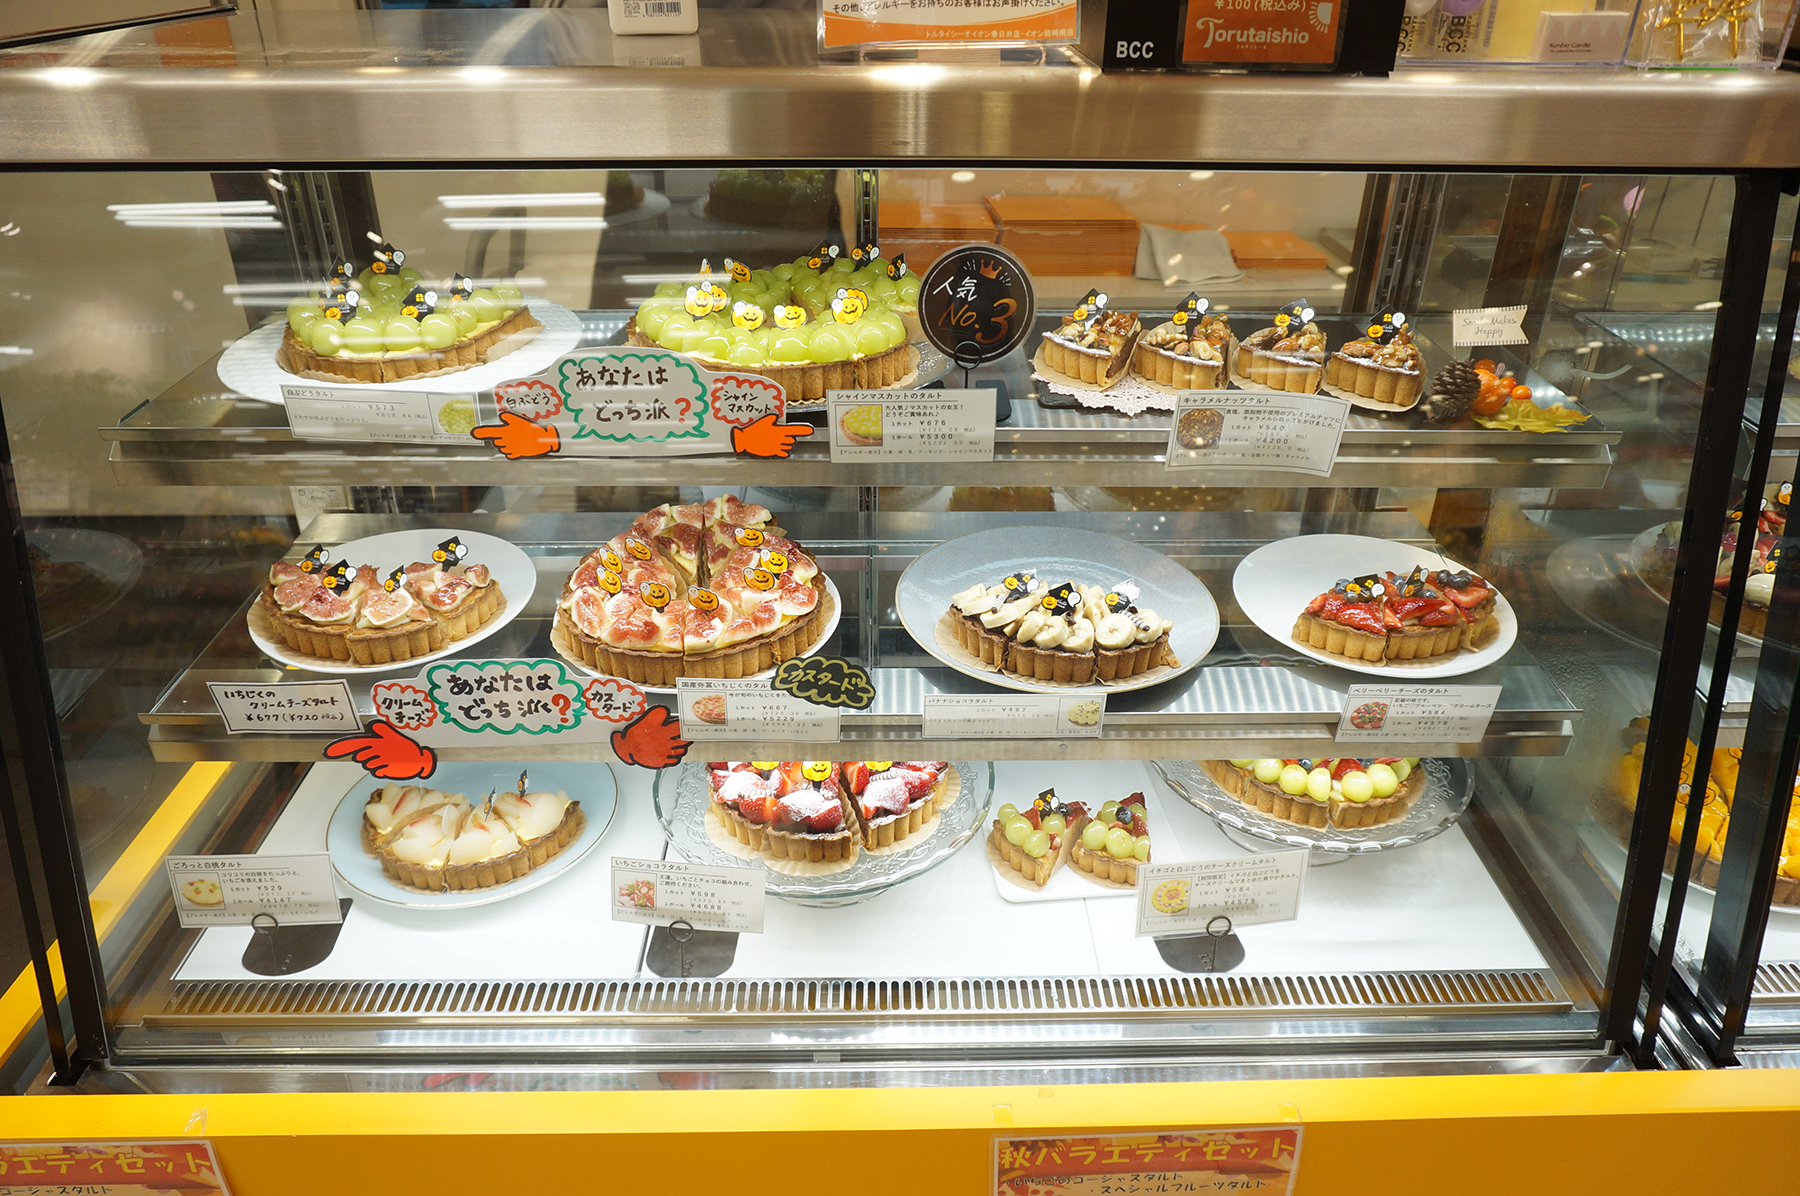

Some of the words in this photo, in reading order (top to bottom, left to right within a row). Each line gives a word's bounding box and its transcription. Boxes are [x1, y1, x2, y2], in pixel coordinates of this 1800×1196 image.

[1196, 16, 1309, 48] Torutaishio
[1116, 40, 1154, 58] BCC
[932, 276, 978, 301] 人気
[1475, 326, 1503, 338] Happy
[576, 366, 669, 392] あなたは
[506, 394, 551, 410] 白ぶどう
[723, 391, 758, 402] シャイン
[836, 392, 942, 400] シャインマスカットのタルト
[1183, 396, 1271, 405] キャラメルナッツタルト
[368, 403, 395, 411] ¥573
[728, 402, 771, 414] マスカット
[447, 671, 554, 695] あなたは
[789, 668, 864, 692] カスタード
[223, 691, 276, 699] いちじくの
[591, 690, 615, 702] カス
[250, 697, 339, 709] クリームチーズタルト
[381, 697, 423, 710] クリーム
[603, 700, 635, 713] タード
[394, 708, 429, 723] チーズ
[173, 861, 242, 869] ごろっと白桃タルト
[615, 860, 690, 872] いちごショコラタルト
[0, 1152, 211, 1175] エティセット
